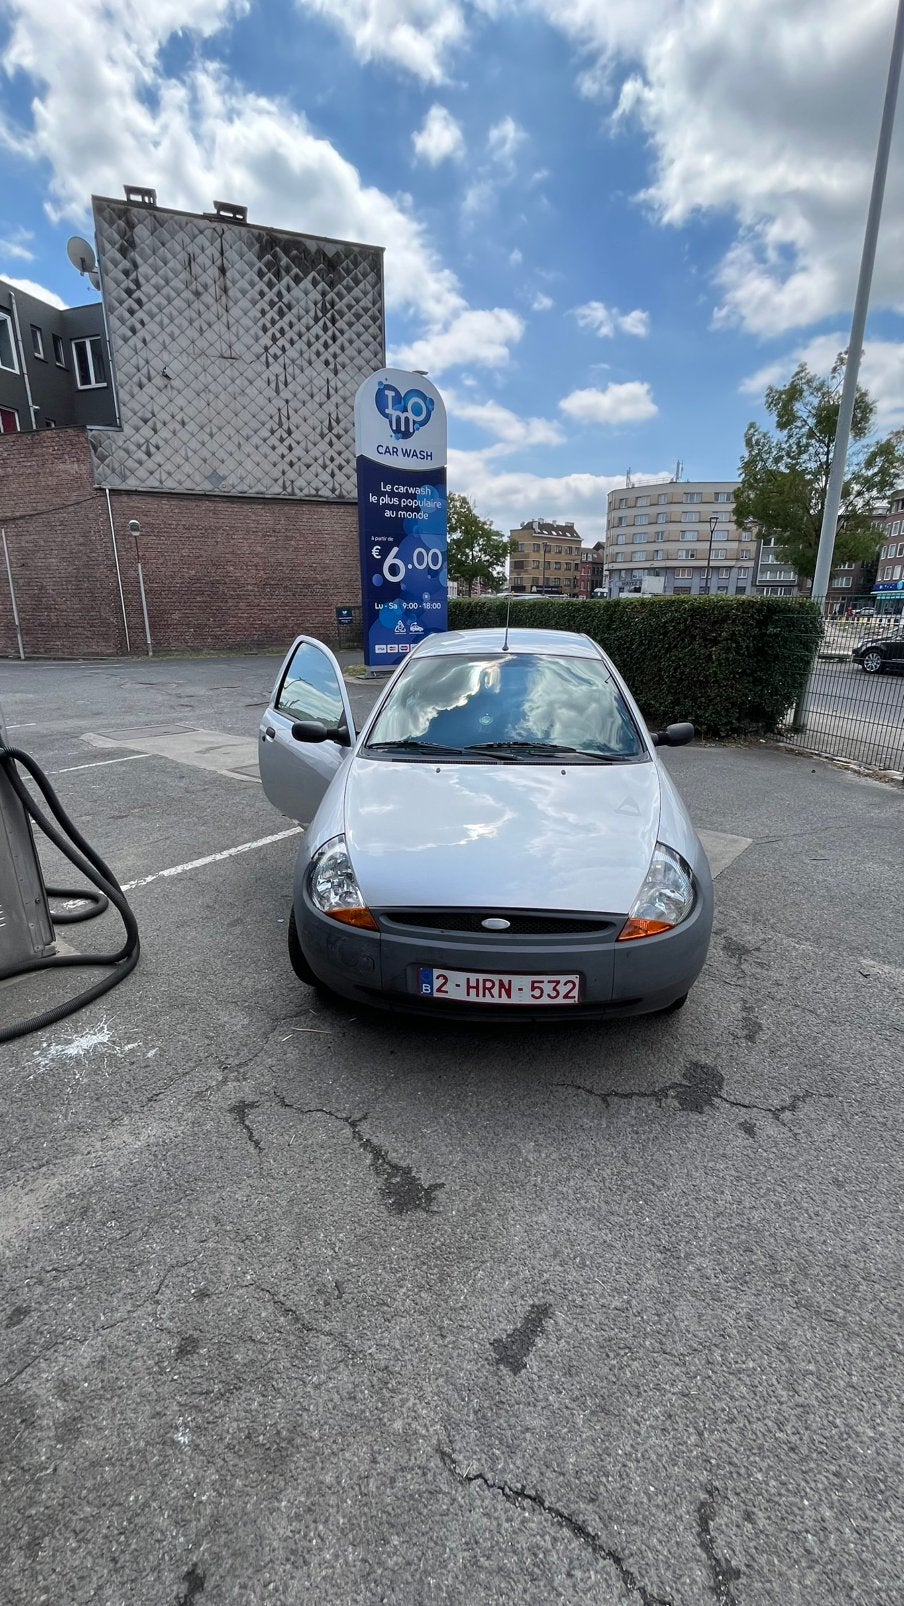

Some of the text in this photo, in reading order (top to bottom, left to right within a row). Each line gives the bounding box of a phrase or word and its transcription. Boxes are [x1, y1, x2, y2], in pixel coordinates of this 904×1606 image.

[376, 444, 433, 461] CAR WASH
[380, 481, 431, 496] Le carwash
[369, 493, 442, 509] le plus populaire
[384, 509, 429, 520] au monde
[374, 602, 384, 610] Lu
[388, 602, 398, 610] Sa
[422, 983, 431, 993] B
